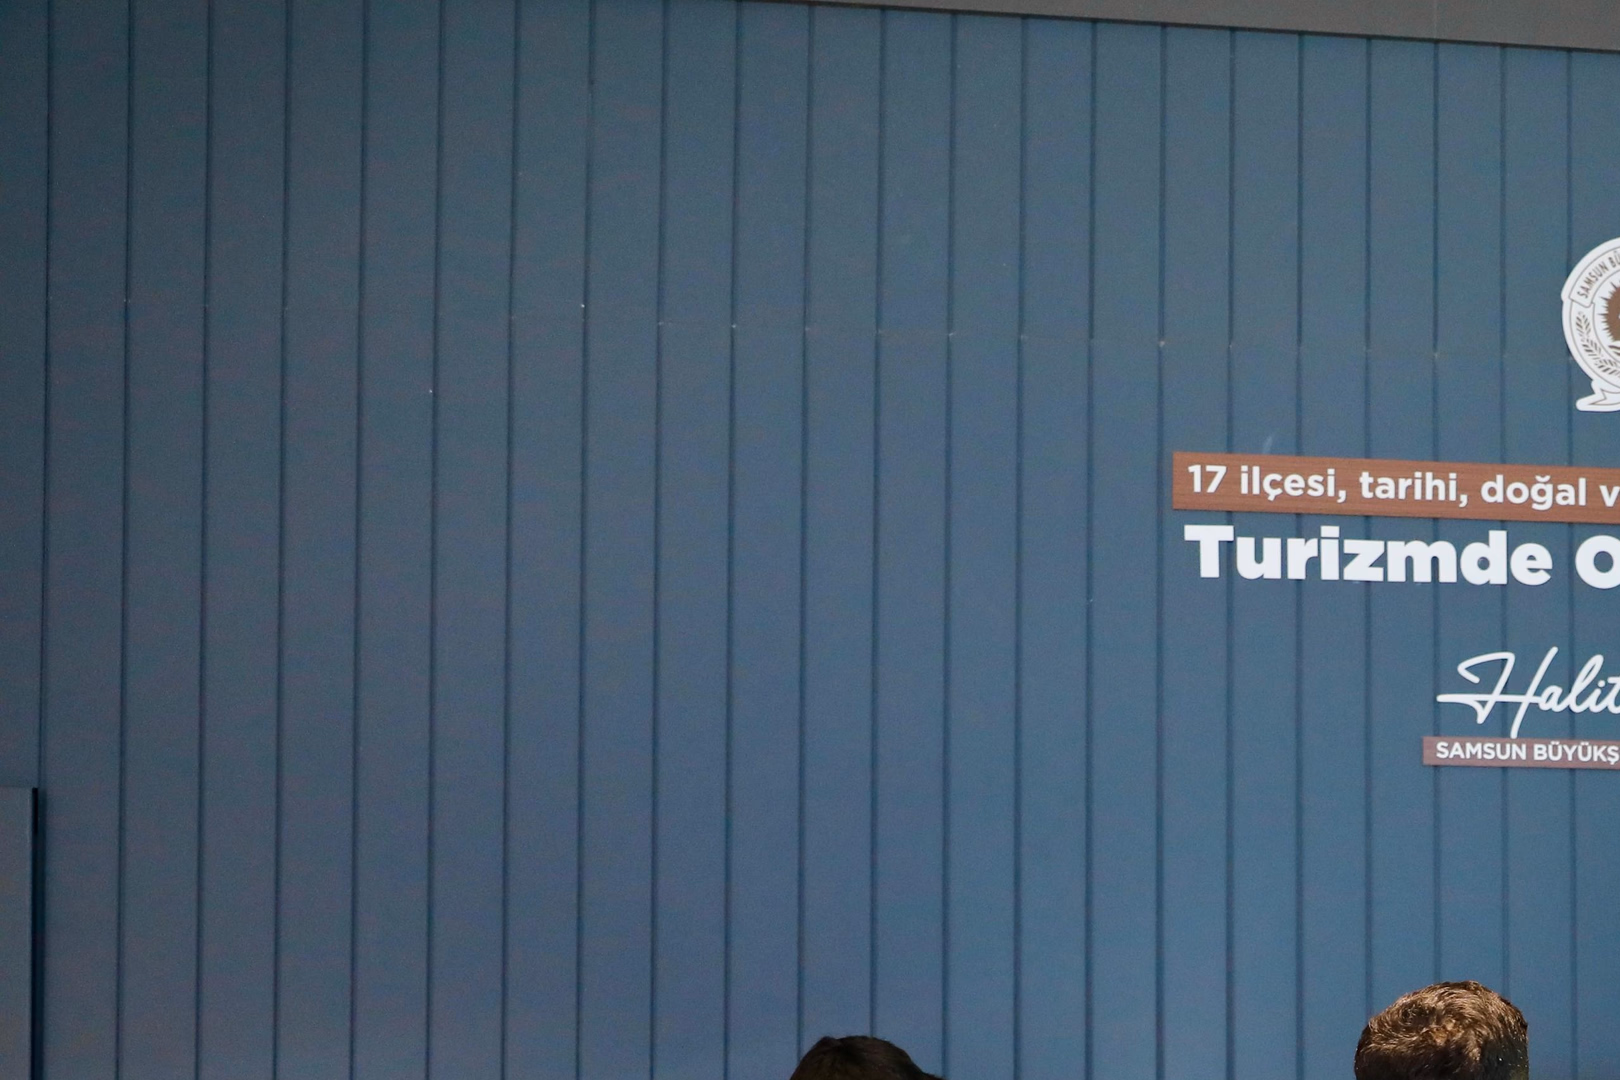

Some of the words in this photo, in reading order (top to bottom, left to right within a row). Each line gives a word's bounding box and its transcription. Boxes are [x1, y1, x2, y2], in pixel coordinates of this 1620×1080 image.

[1577, 263, 1609, 298] SAMSUN
[1188, 464, 1227, 494] 17
[1240, 465, 1347, 503] ilçesi,
[1359, 470, 1468, 508] tarihi,
[1480, 475, 1587, 511] doğal
[1183, 525, 1553, 586] Turizmde
[1436, 741, 1527, 761] SAMSUN
